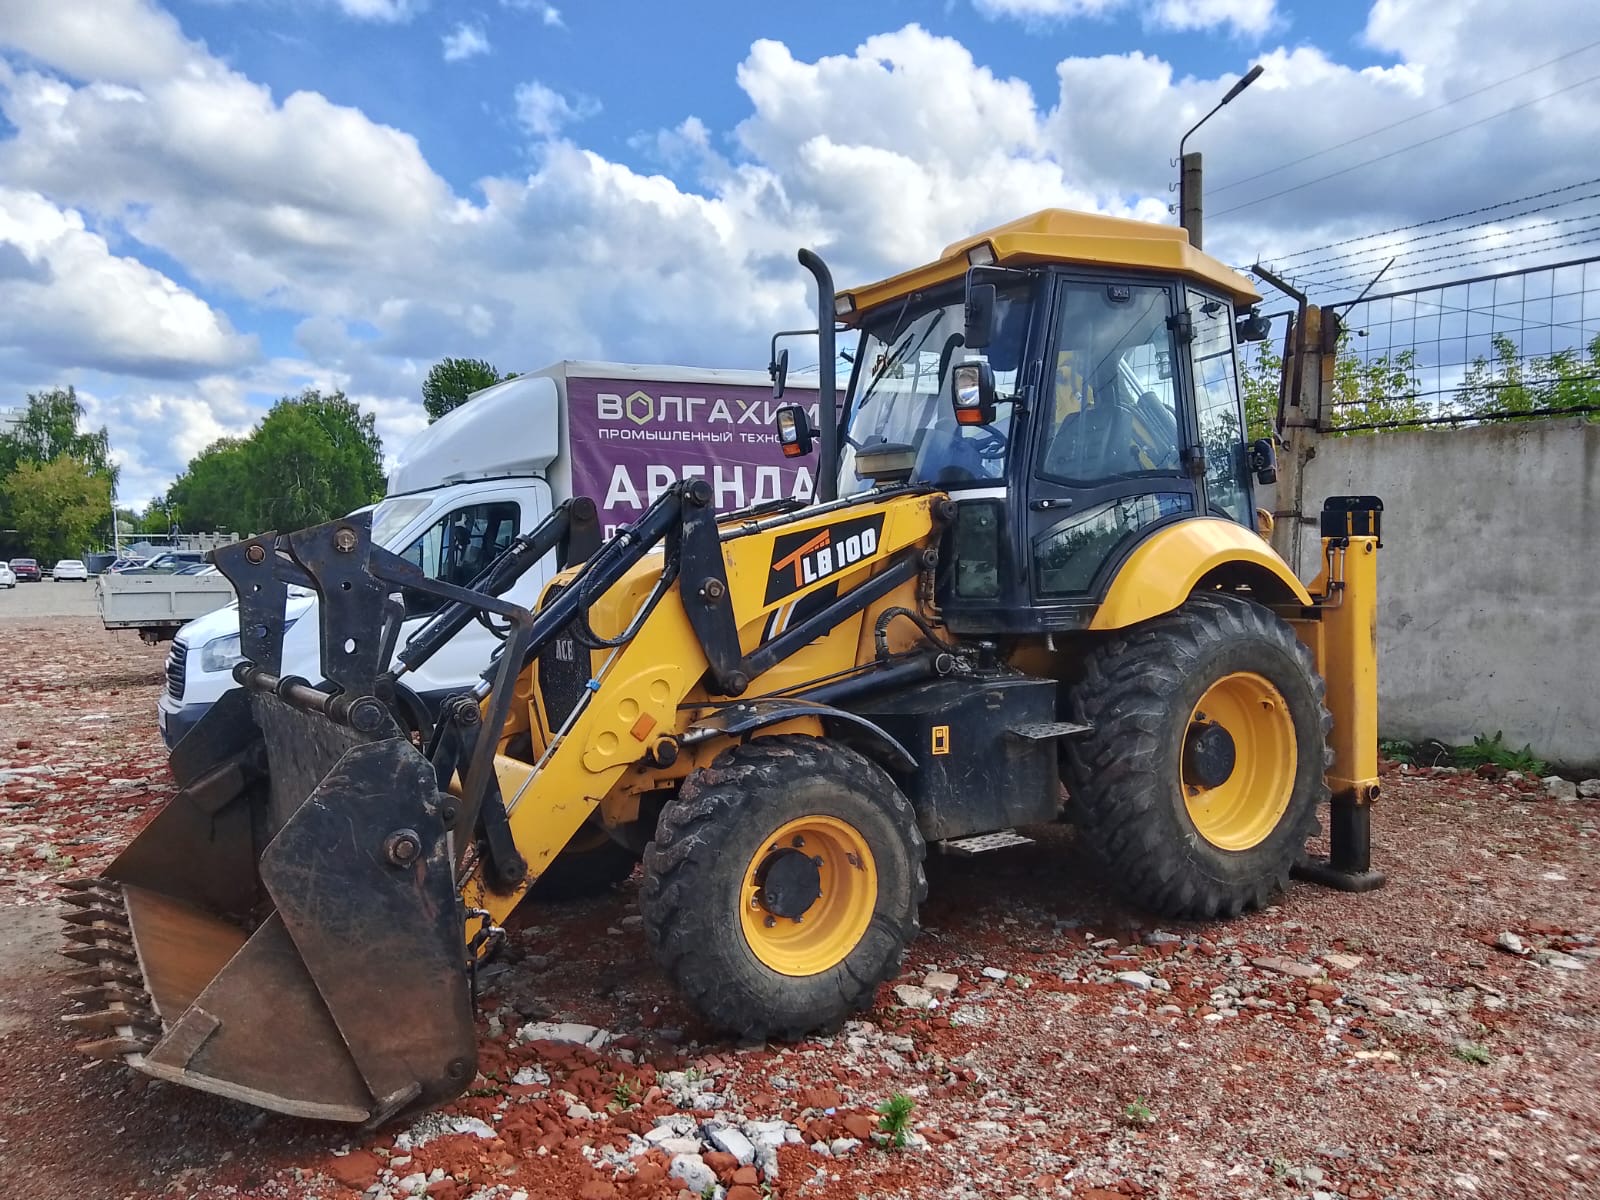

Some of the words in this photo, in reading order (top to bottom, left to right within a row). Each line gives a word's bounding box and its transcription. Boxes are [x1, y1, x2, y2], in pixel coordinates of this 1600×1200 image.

[598, 428, 734, 442] ПРОМЫШЛЕННЫЙ
[772, 528, 832, 588] TLB
[836, 527, 877, 568] 100
